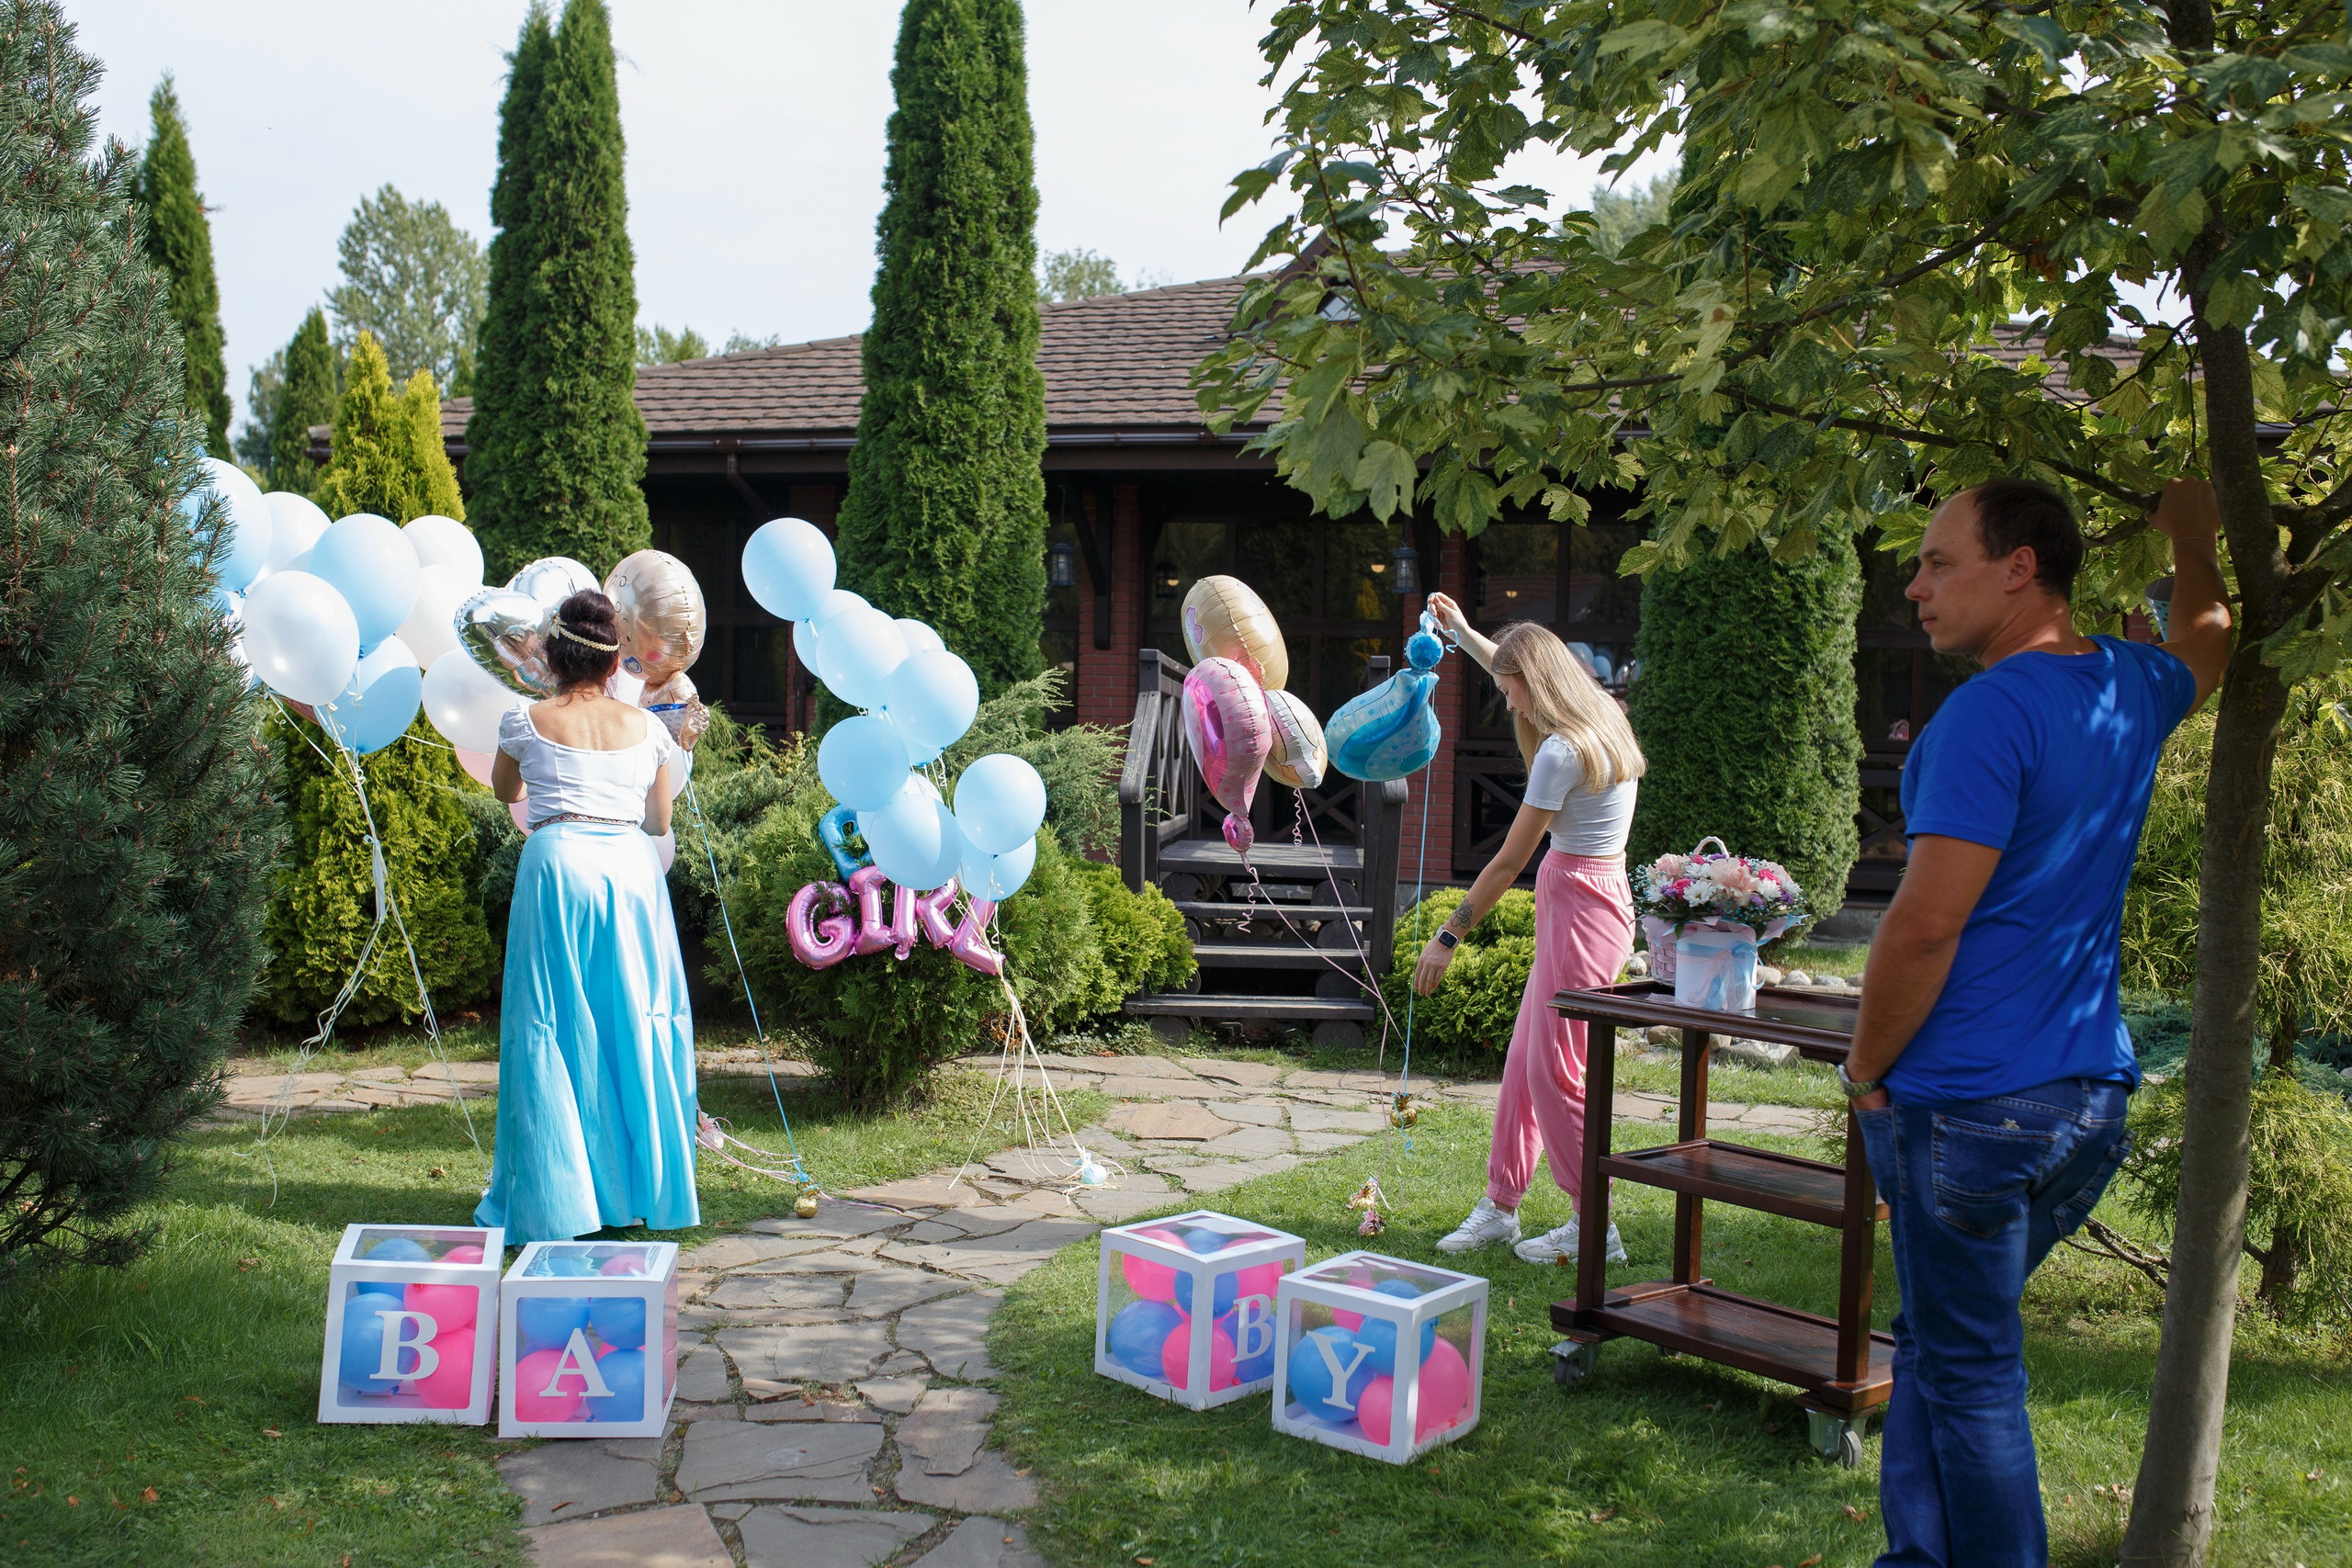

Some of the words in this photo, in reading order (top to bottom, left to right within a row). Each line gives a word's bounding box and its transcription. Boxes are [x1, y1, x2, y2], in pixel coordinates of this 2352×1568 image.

[786, 864, 1006, 976] GIRL
[369, 1311, 439, 1381] B
[539, 1327, 615, 1397] A
[1230, 1293, 1273, 1364] B
[1306, 1330, 1375, 1411] Y
